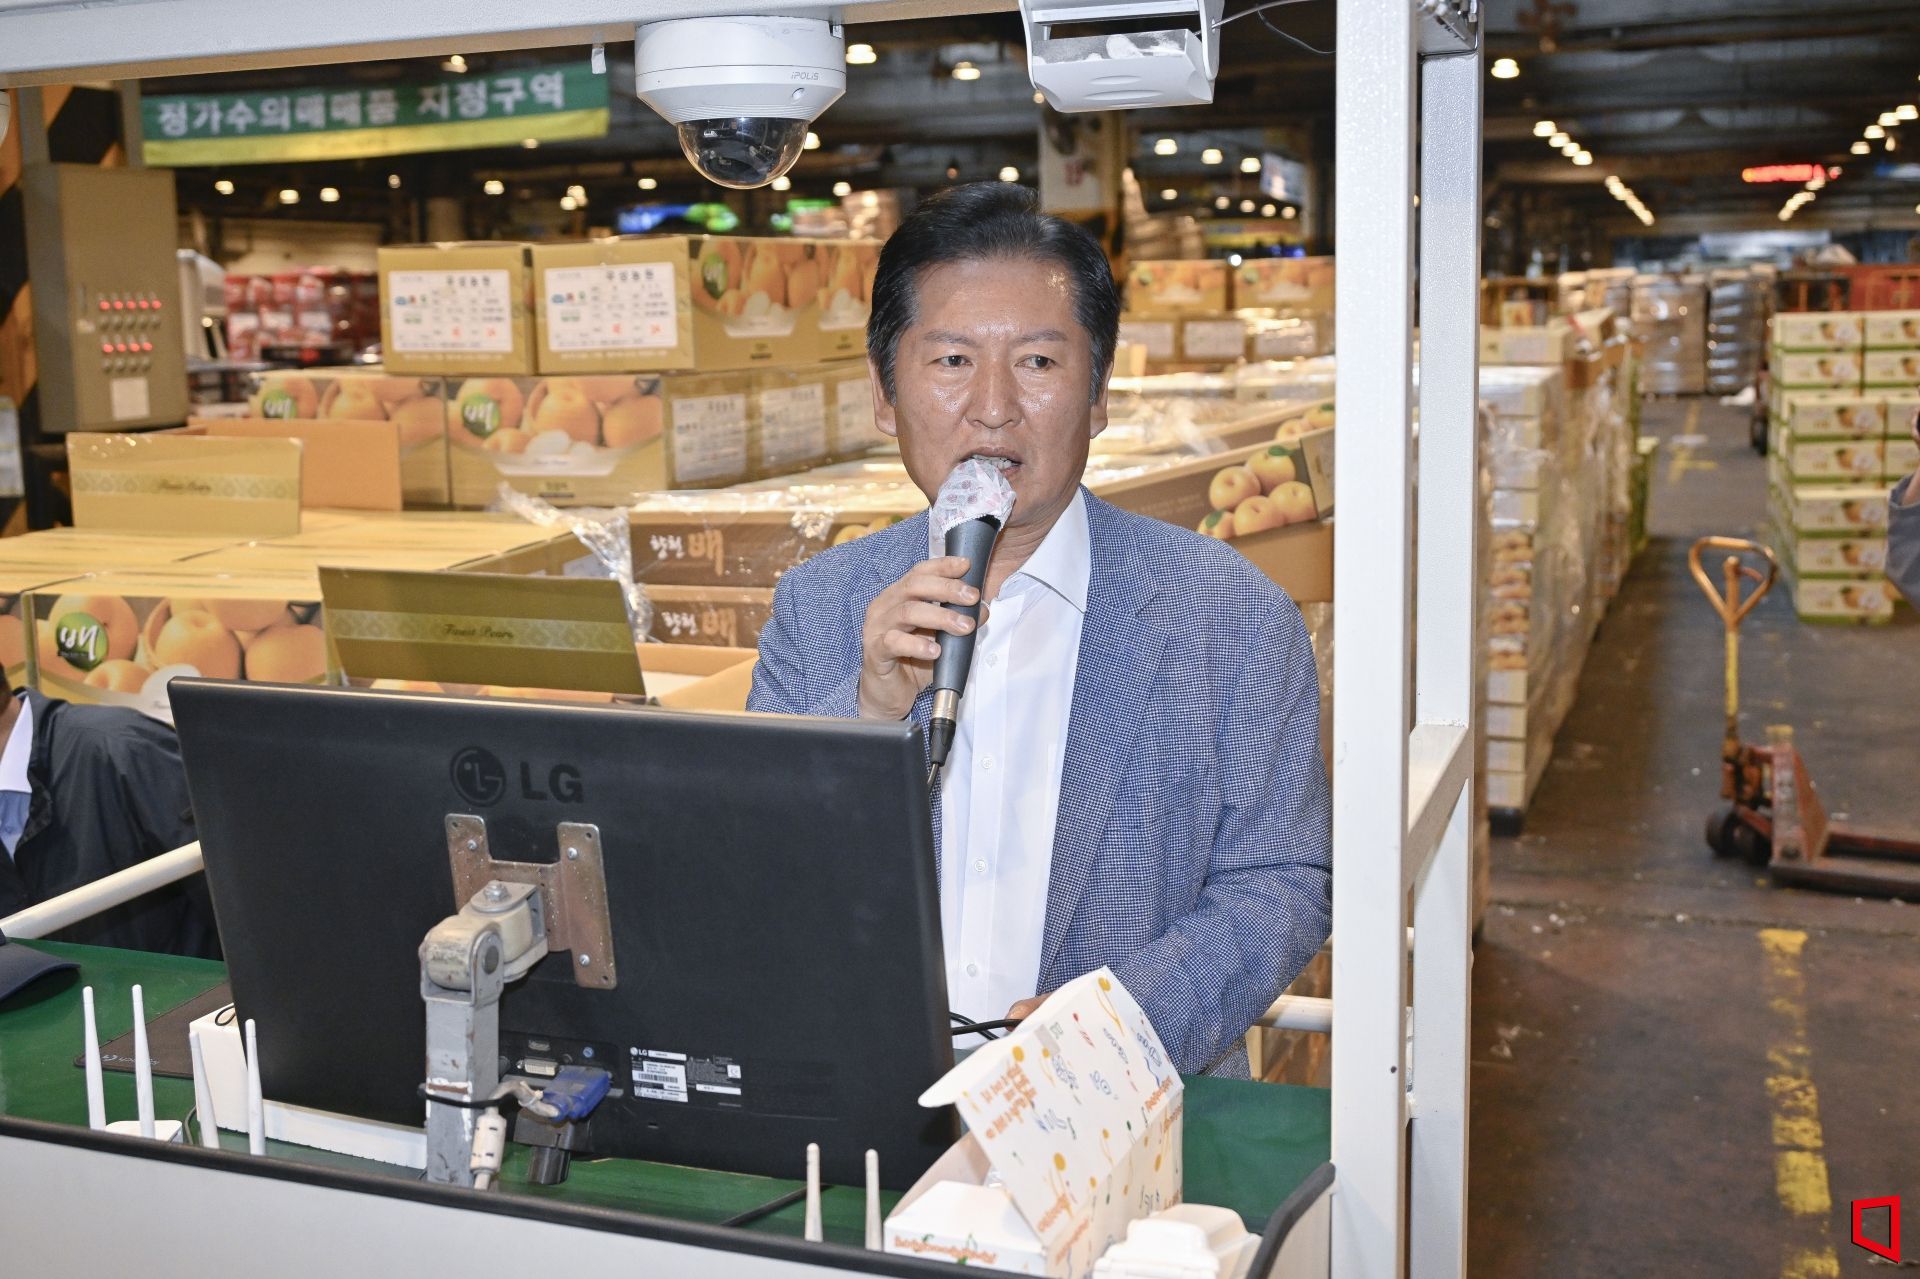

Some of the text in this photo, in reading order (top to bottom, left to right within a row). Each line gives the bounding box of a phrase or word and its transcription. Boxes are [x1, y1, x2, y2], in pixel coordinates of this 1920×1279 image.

[417, 71, 565, 119] 지정구역
[687, 529, 724, 577] 배
[60, 624, 99, 662] 배
[702, 607, 737, 647] 배
[519, 760, 585, 804] LG
